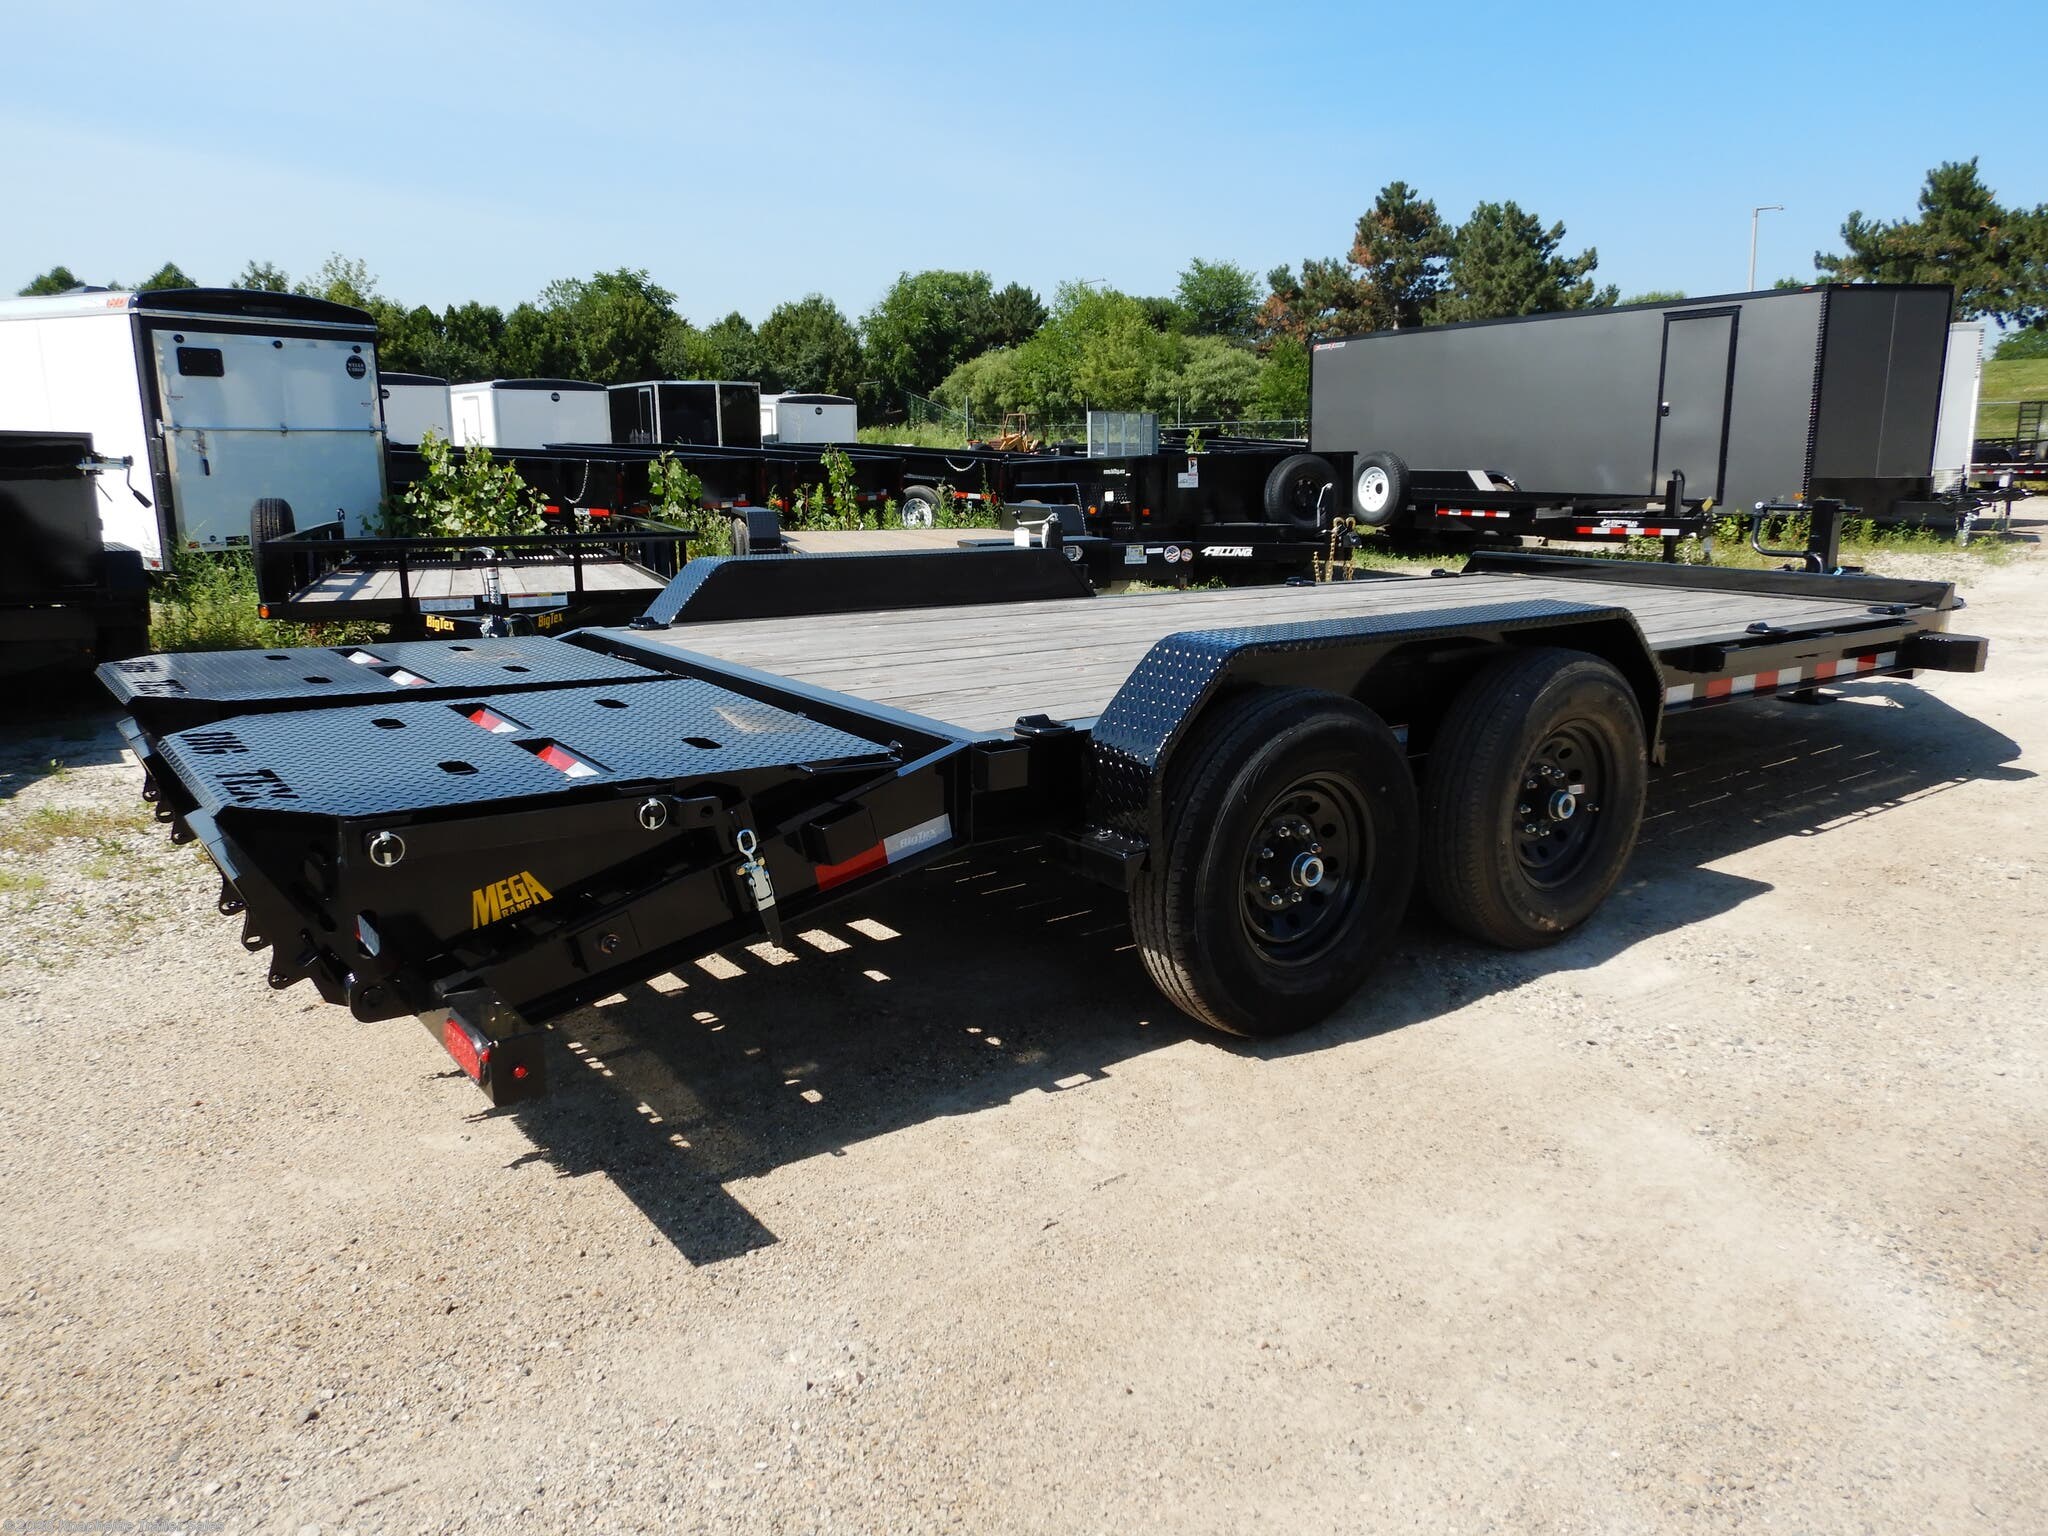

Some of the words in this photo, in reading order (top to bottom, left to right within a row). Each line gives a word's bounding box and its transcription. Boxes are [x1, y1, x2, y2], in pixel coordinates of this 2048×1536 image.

[426, 615, 454, 631] BigTex
[538, 612, 563, 628] BigTex
[215, 768, 300, 803] TEX
[472, 870, 554, 930] MEGA
[501, 900, 532, 918] RAMP
